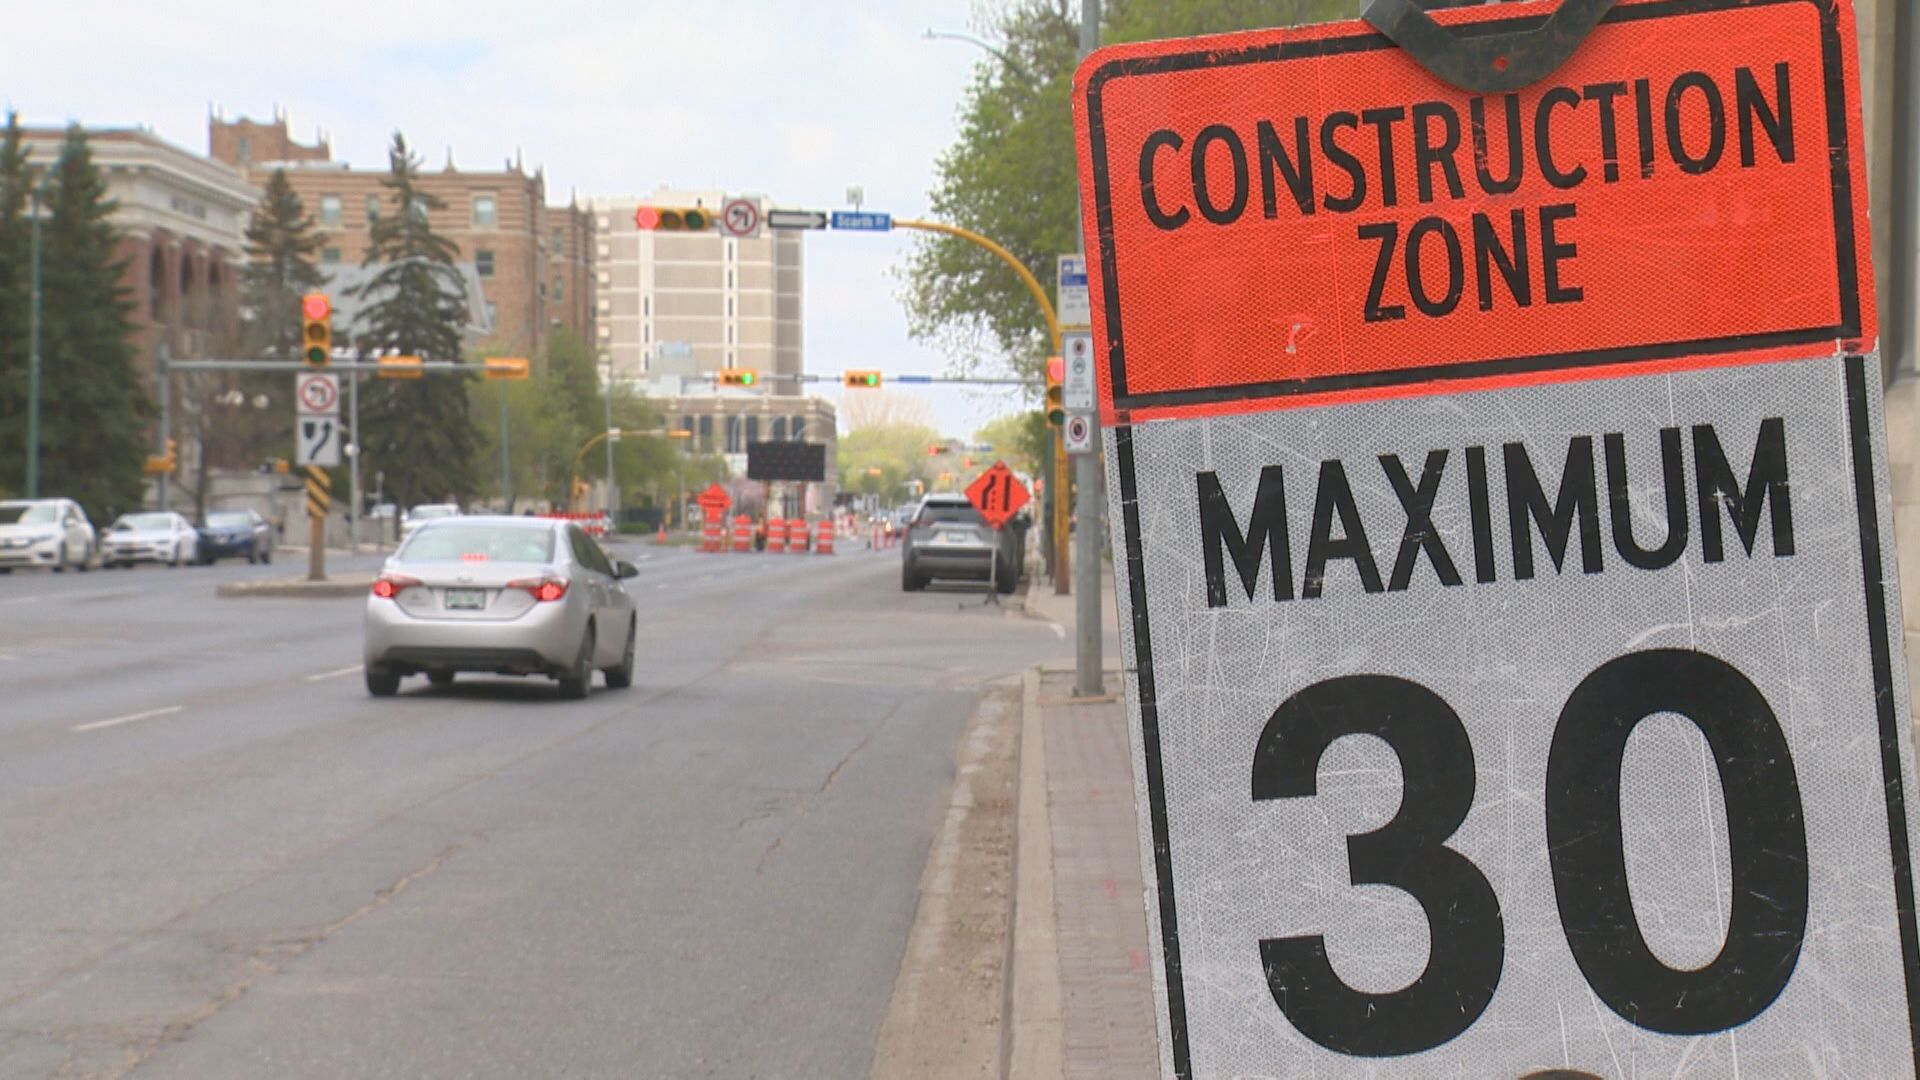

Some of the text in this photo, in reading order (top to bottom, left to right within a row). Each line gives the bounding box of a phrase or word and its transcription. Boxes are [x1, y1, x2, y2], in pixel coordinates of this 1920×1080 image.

[1138, 62, 1795, 230] CONSTRUCTION
[1358, 203, 1584, 322] ZONE
[1197, 417, 1795, 609] MAXIMUM
[1251, 647, 1809, 1057] 30
